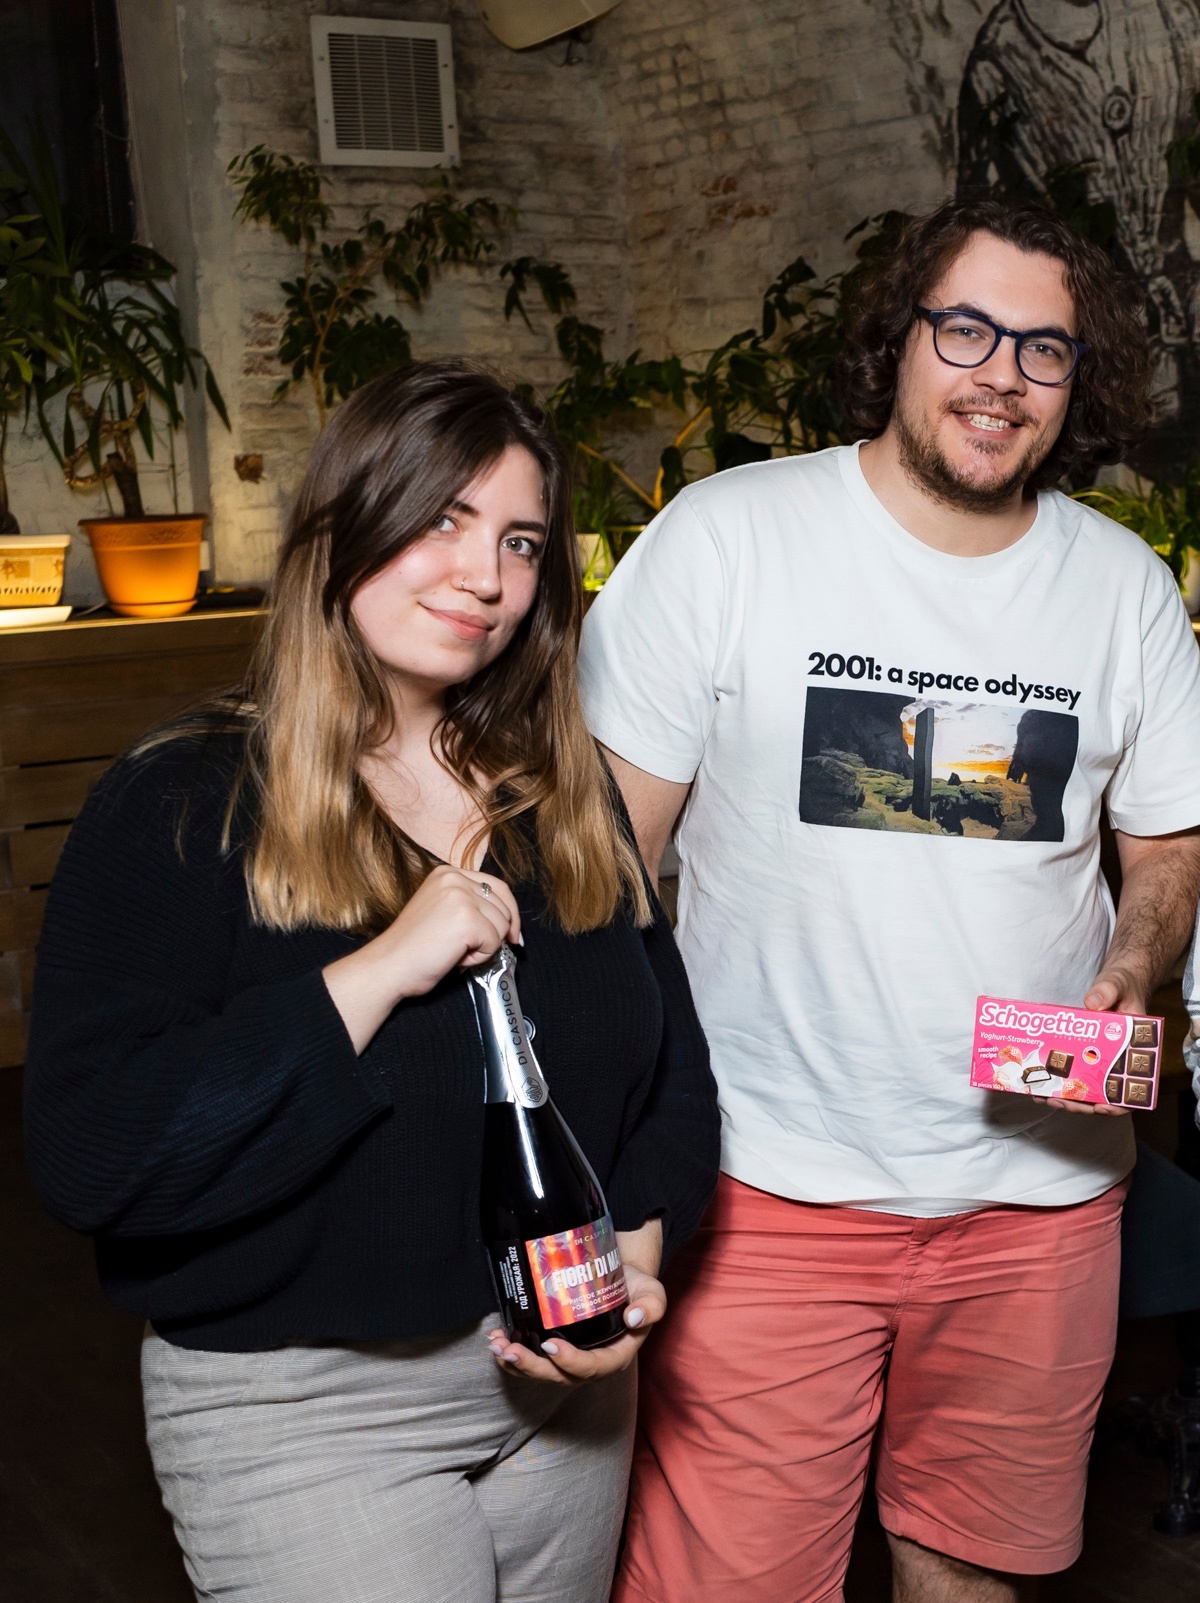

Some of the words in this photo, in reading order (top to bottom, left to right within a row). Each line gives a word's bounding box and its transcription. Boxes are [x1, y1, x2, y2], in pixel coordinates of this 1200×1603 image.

[807, 651, 882, 681] 2001:
[887, 666, 903, 684] a
[907, 670, 979, 693] space
[984, 674, 1082, 711] odyssey
[500, 980, 522, 1046] CASPICO
[979, 1002, 1100, 1039] Schogetten
[979, 1031, 1043, 1047] Yoghurt-Strawberry
[515, 1050, 528, 1065] DI
[507, 1246, 519, 1262] 2022
[574, 1238, 583, 1246] DI
[511, 1263, 526, 1296] УРОЖАЯ:
[552, 1262, 593, 1292] FIORI
[594, 1254, 608, 1278] DI
[519, 1295, 529, 1310] ГОД
